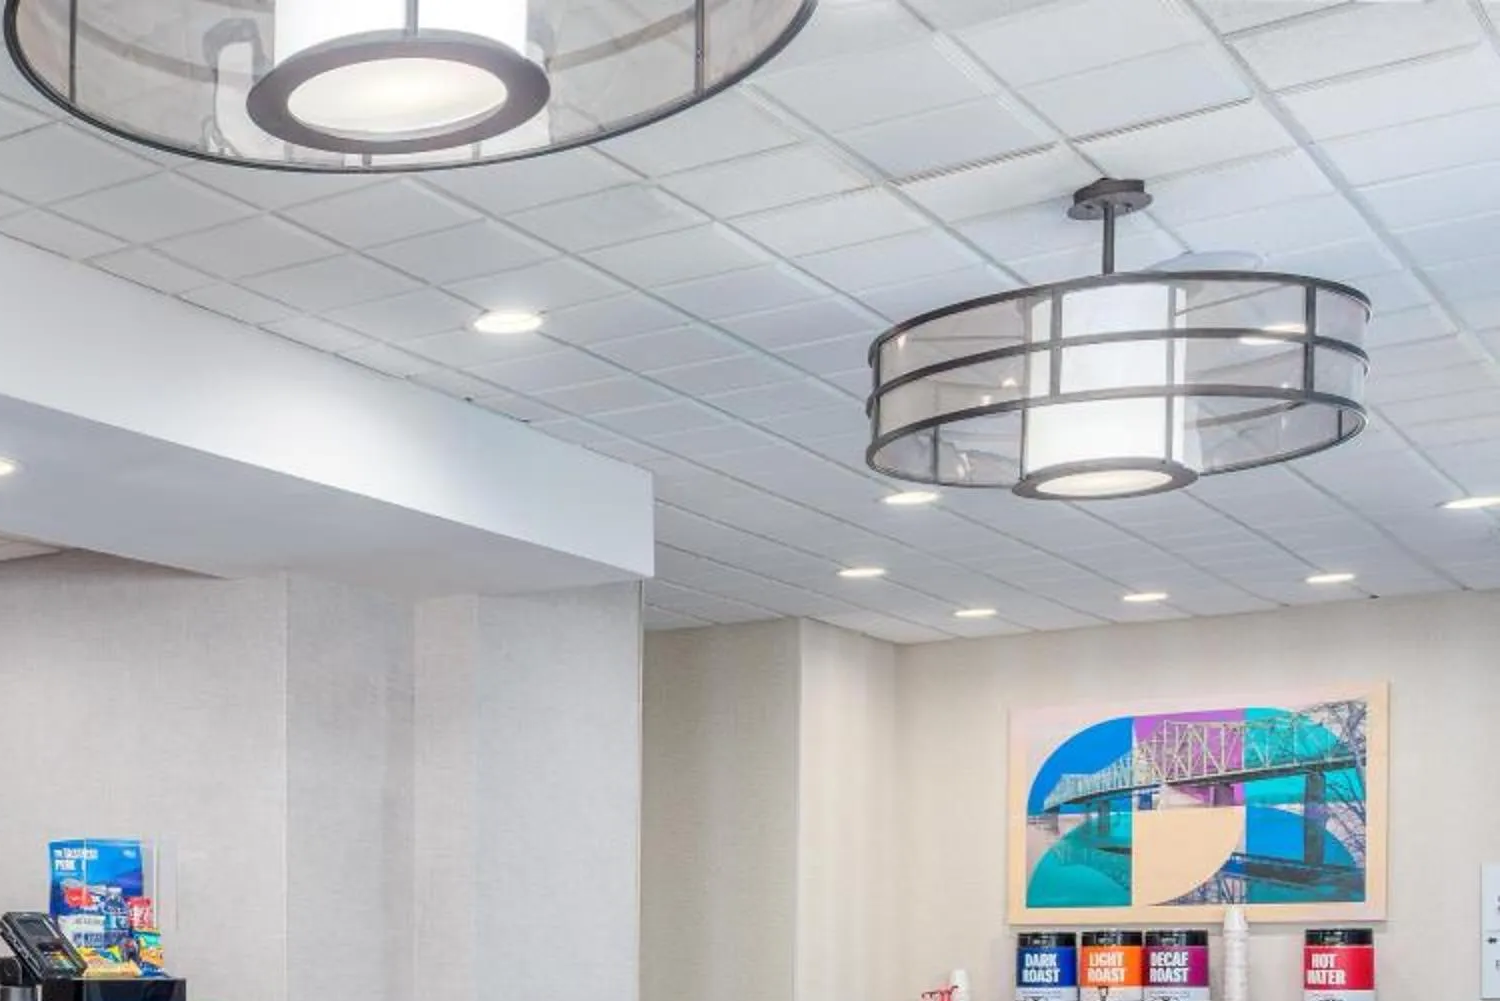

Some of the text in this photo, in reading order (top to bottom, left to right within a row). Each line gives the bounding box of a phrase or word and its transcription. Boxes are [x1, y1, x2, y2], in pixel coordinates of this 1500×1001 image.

[1025, 953, 1057, 967] DARK
[1089, 952, 1124, 967] LIGHT
[1150, 951, 1189, 967] DECAF
[1311, 953, 1337, 968] HOT
[1022, 968, 1060, 983] ROAST
[1087, 967, 1125, 983] ROAST
[1149, 967, 1189, 983] ROAST
